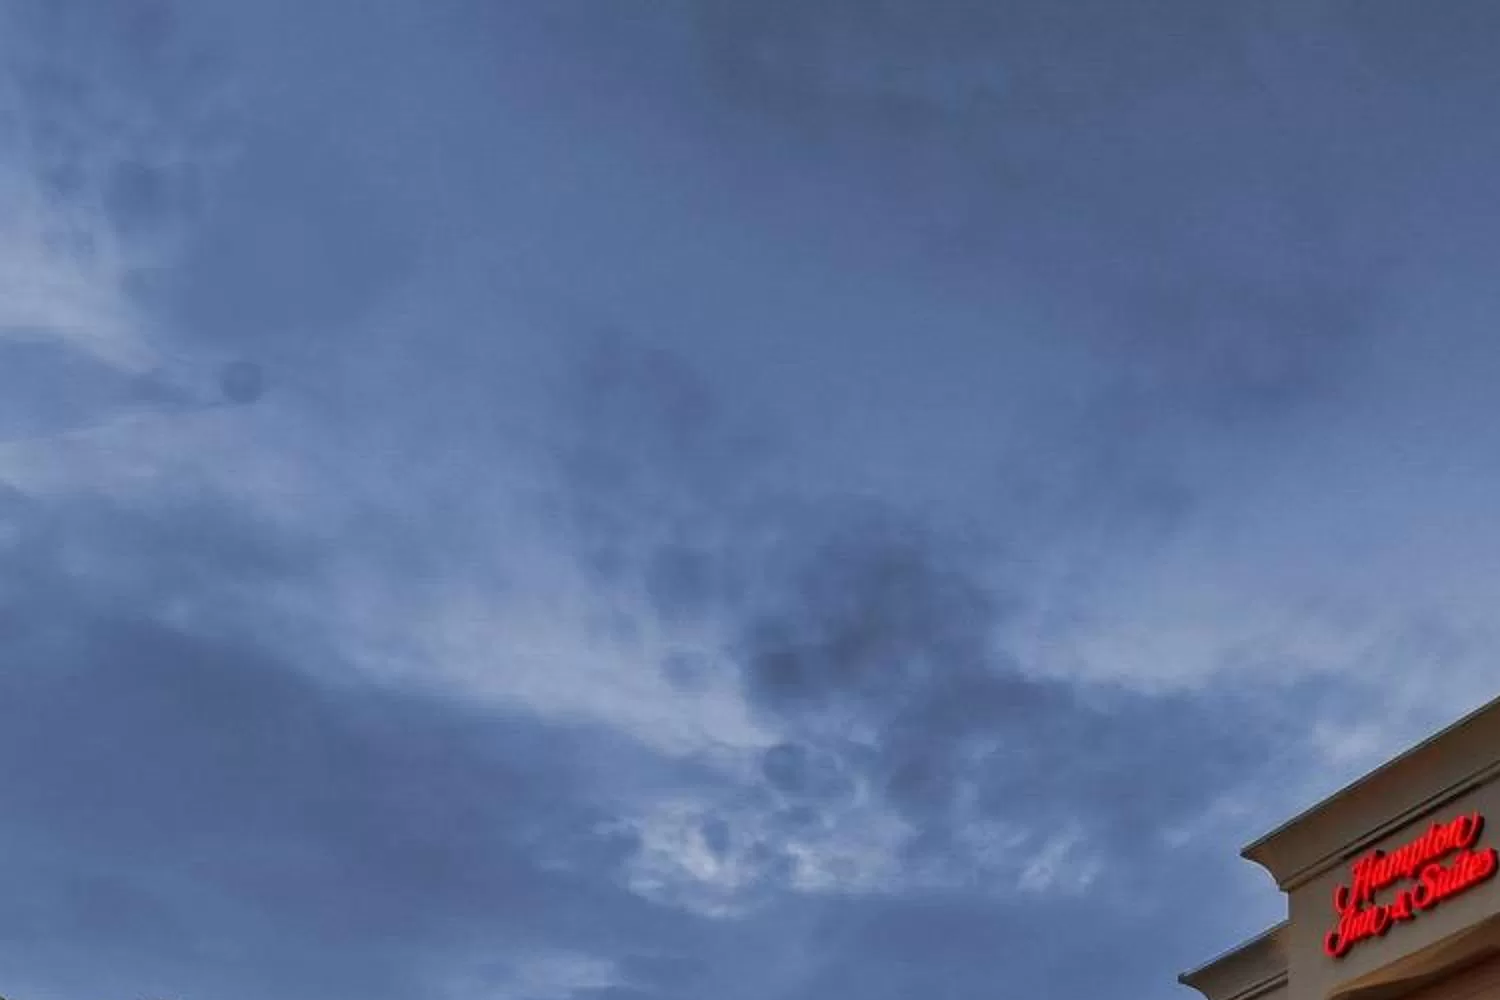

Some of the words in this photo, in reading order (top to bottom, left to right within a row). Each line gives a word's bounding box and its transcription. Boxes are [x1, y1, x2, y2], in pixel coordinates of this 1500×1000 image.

[1323, 903, 1393, 959] Inn
[1411, 848, 1499, 911] Suites
[1333, 811, 1485, 915] Hampton
